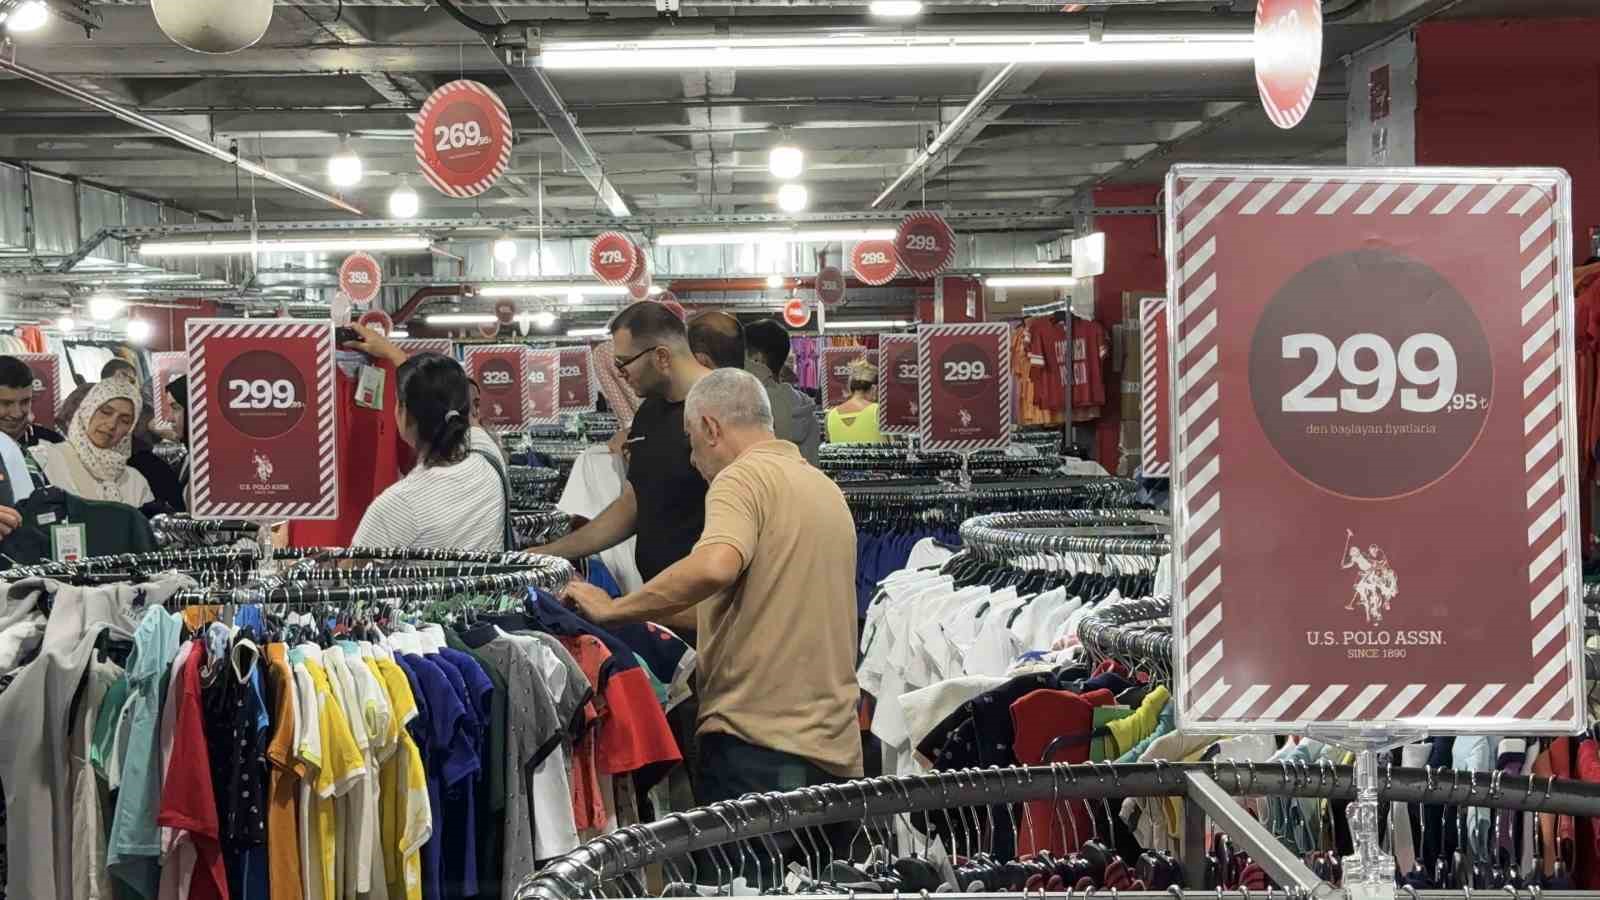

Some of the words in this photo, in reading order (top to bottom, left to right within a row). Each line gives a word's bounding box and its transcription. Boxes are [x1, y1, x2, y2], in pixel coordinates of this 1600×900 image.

[1305, 423, 1328, 434] den
[1306, 630, 1339, 646] U.S.
[1343, 630, 1391, 646] POLO
[1394, 630, 1447, 646] ASSN.
[1347, 648, 1380, 659] SINCE
[1383, 648, 1407, 659] 1890
